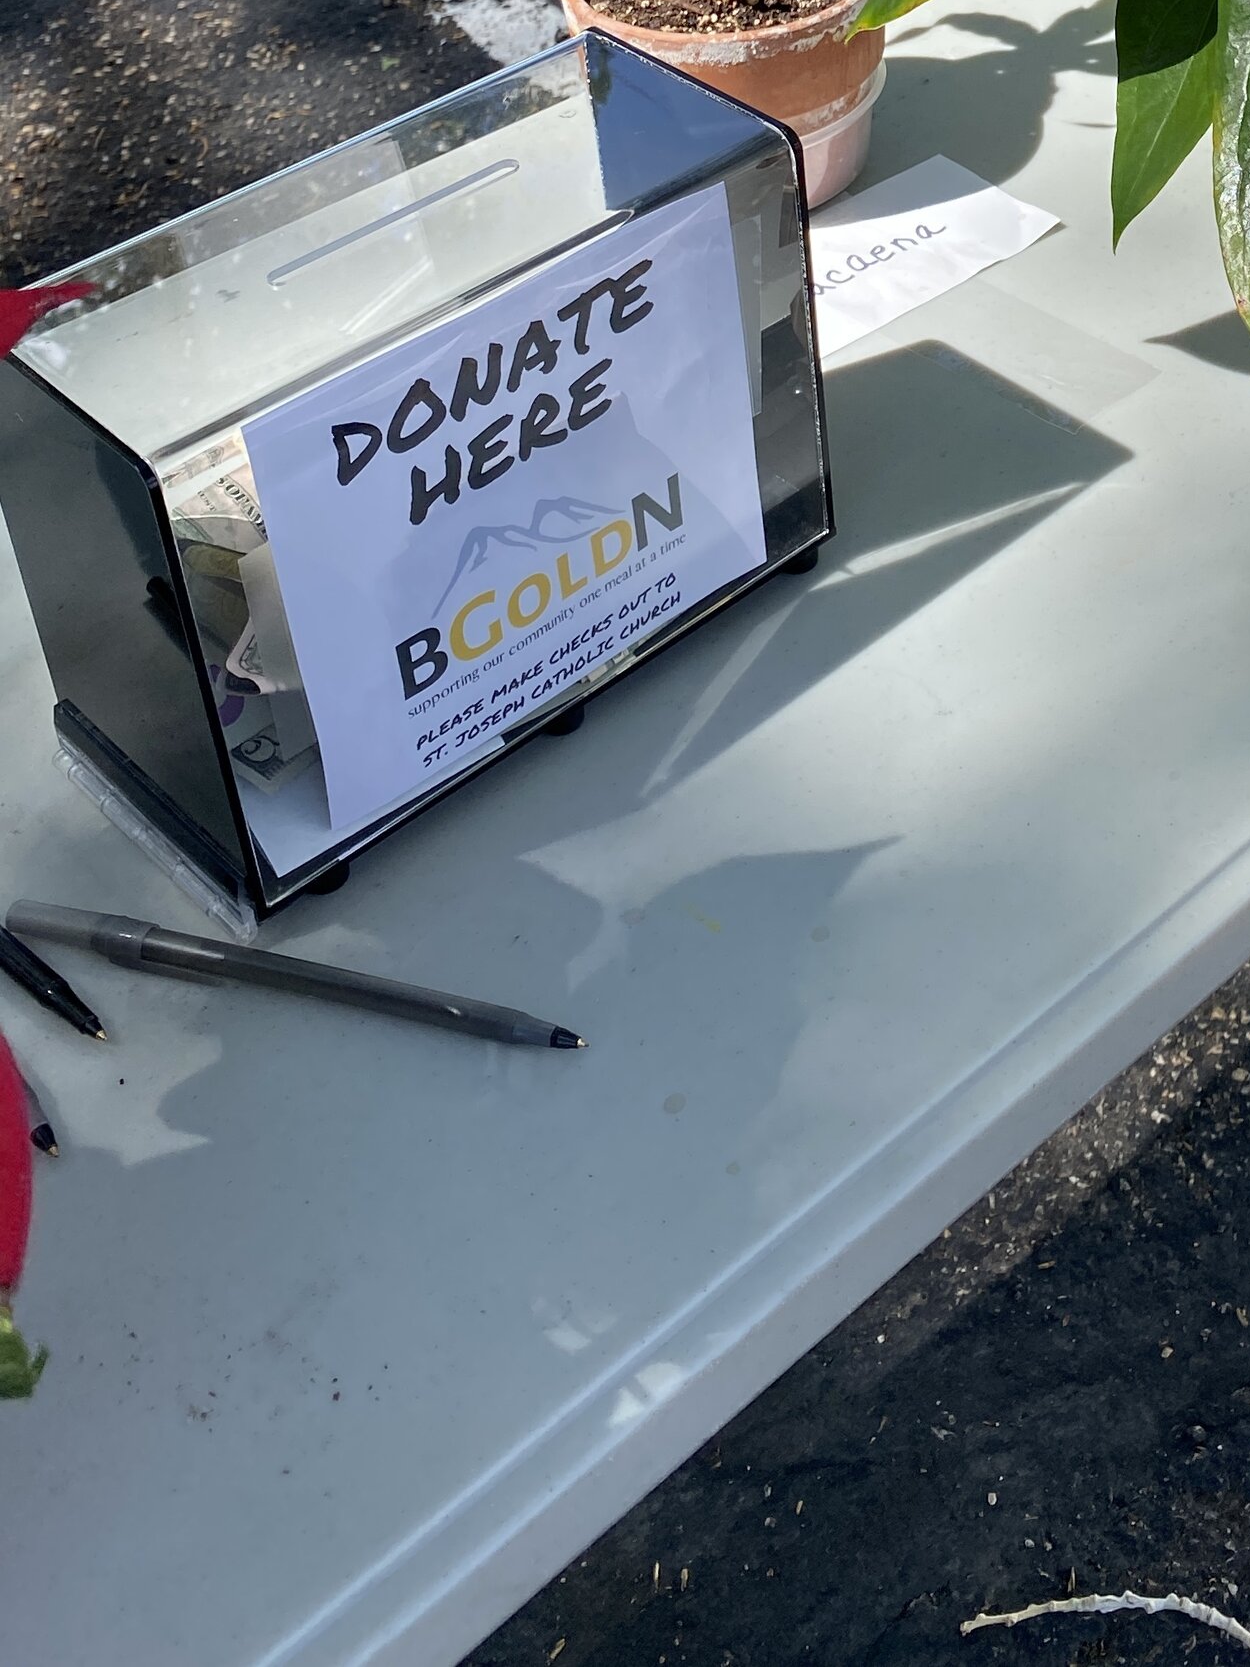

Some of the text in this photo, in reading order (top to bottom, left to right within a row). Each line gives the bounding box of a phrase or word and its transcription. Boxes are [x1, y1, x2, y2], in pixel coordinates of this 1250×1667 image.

[331, 259, 654, 486] DONATE
[409, 358, 613, 525] HERE
[395, 473, 684, 701] BGOLDN
[408, 533, 687, 720] supporting our community one meal at a time
[416, 572, 677, 751] PLEASE MAKE CHECKS OUT TO
[422, 591, 682, 769] ST. JOSEPH CATHOLIC CHURCH
